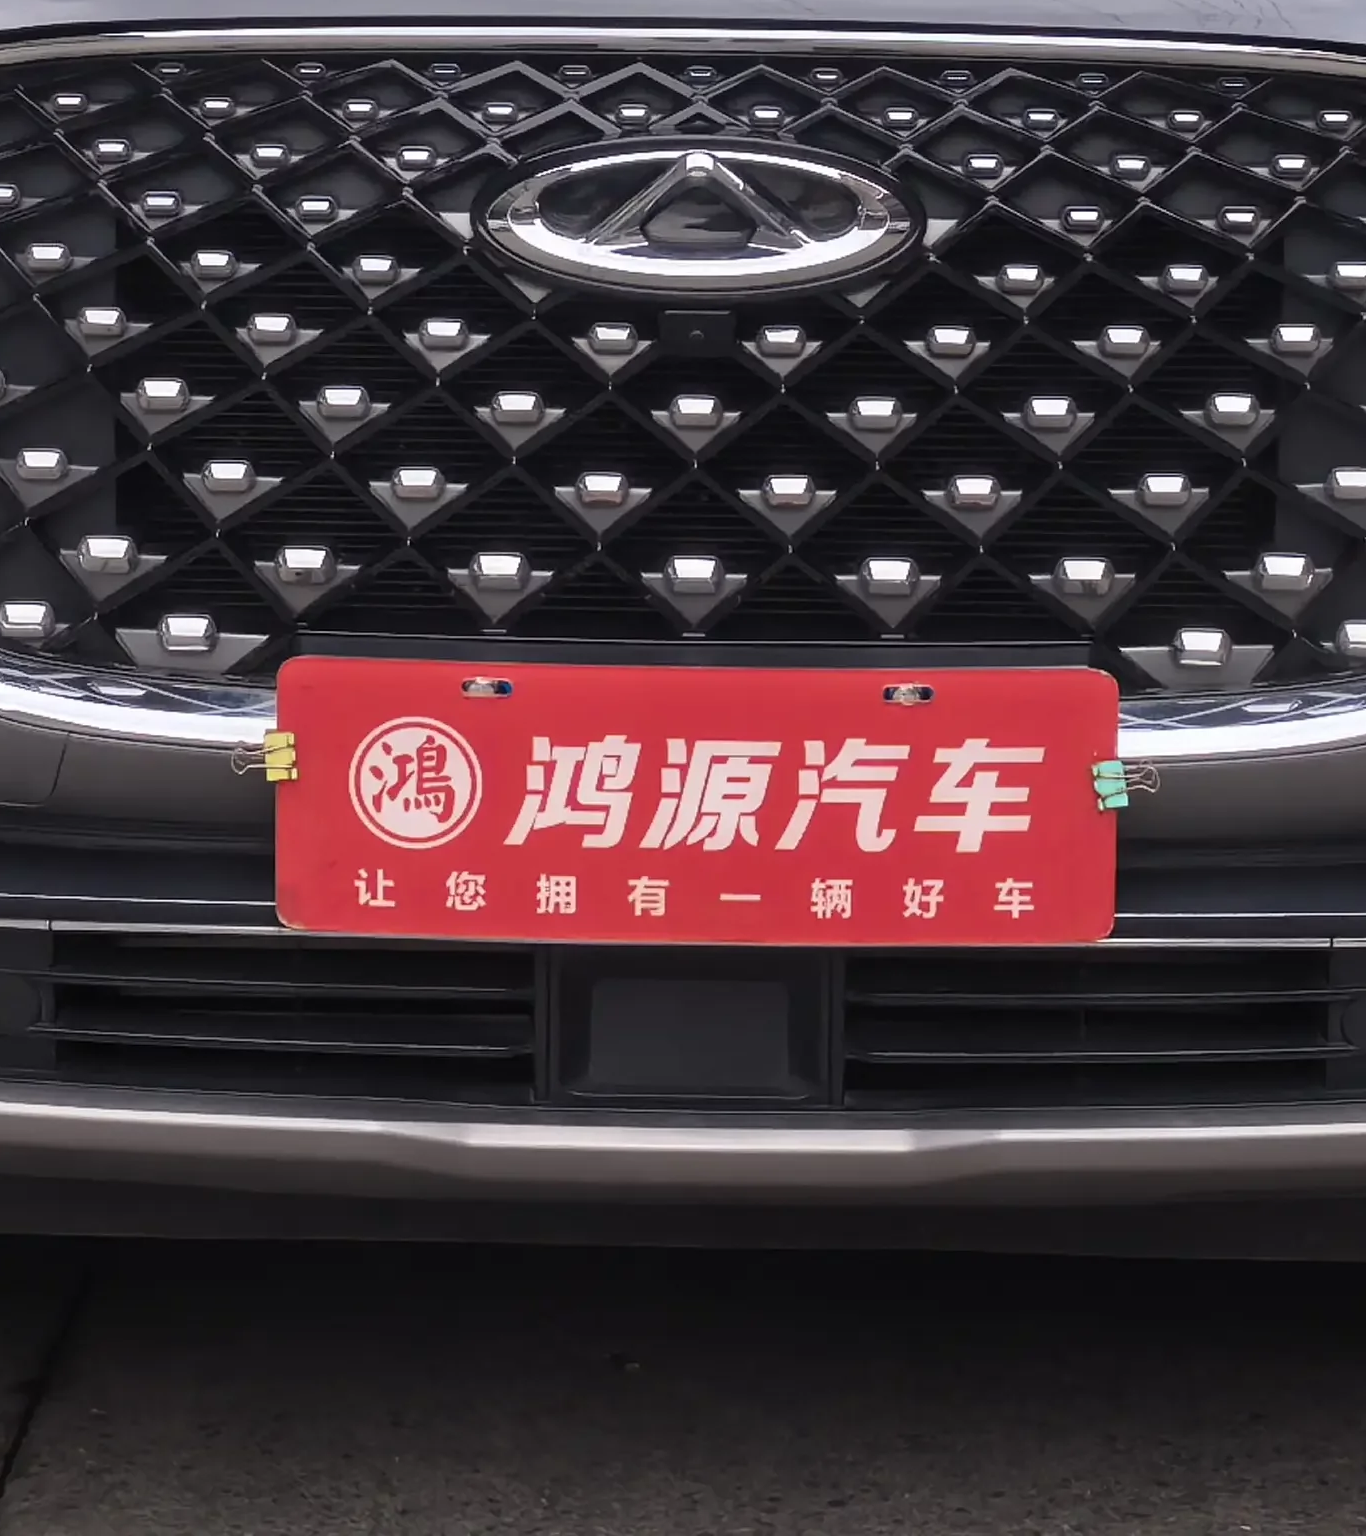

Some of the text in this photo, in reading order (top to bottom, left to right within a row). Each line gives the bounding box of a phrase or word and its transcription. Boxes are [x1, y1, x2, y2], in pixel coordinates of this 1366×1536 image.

[503, 734, 1046, 854] 鸿源汽车
[353, 868, 1036, 921] 让您拥有一辆好车
